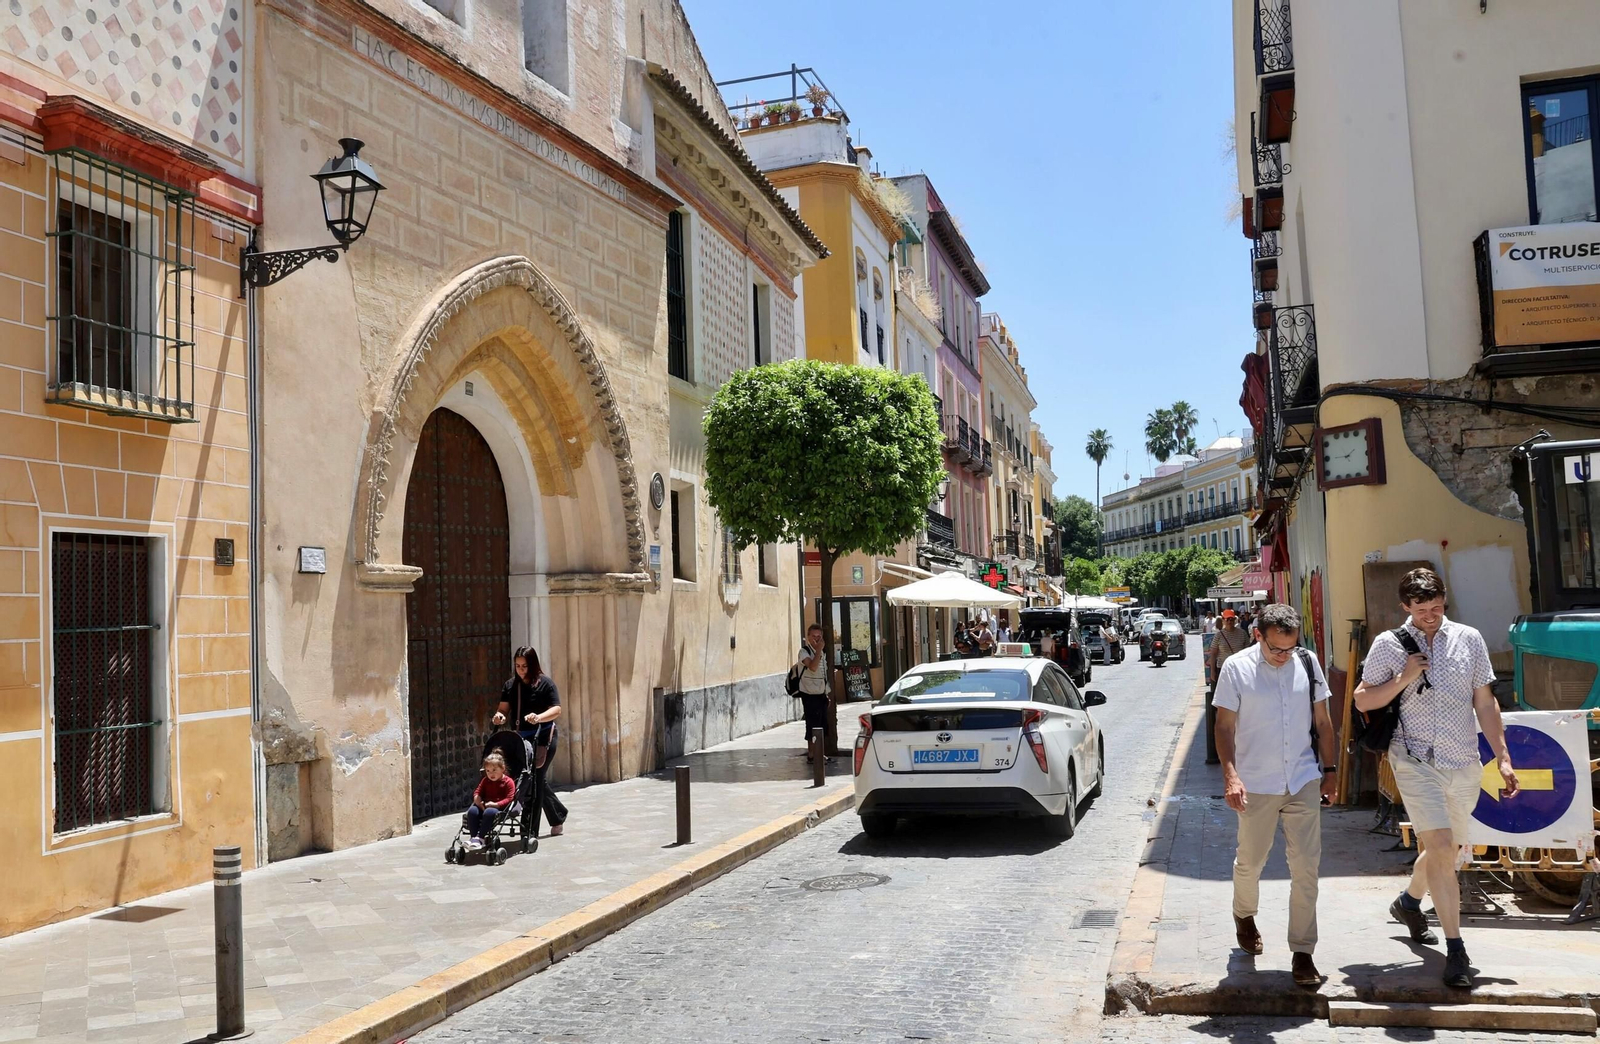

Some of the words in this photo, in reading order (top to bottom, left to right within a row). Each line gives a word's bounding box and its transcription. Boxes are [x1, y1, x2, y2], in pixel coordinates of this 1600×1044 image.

[354, 26, 396, 73] HAC
[407, 58, 435, 92] EST
[440, 78, 493, 127] DOMVS
[534, 134, 571, 171] PORTA
[1526, 304, 1561, 312] ARQUITECTO
[1526, 318, 1561, 326] ARQUITECTO
[1244, 575, 1271, 587] MOYA
[921, 751, 950, 760] 4687
[954, 750, 977, 760] JXJ
[995, 759, 1010, 767] 374
